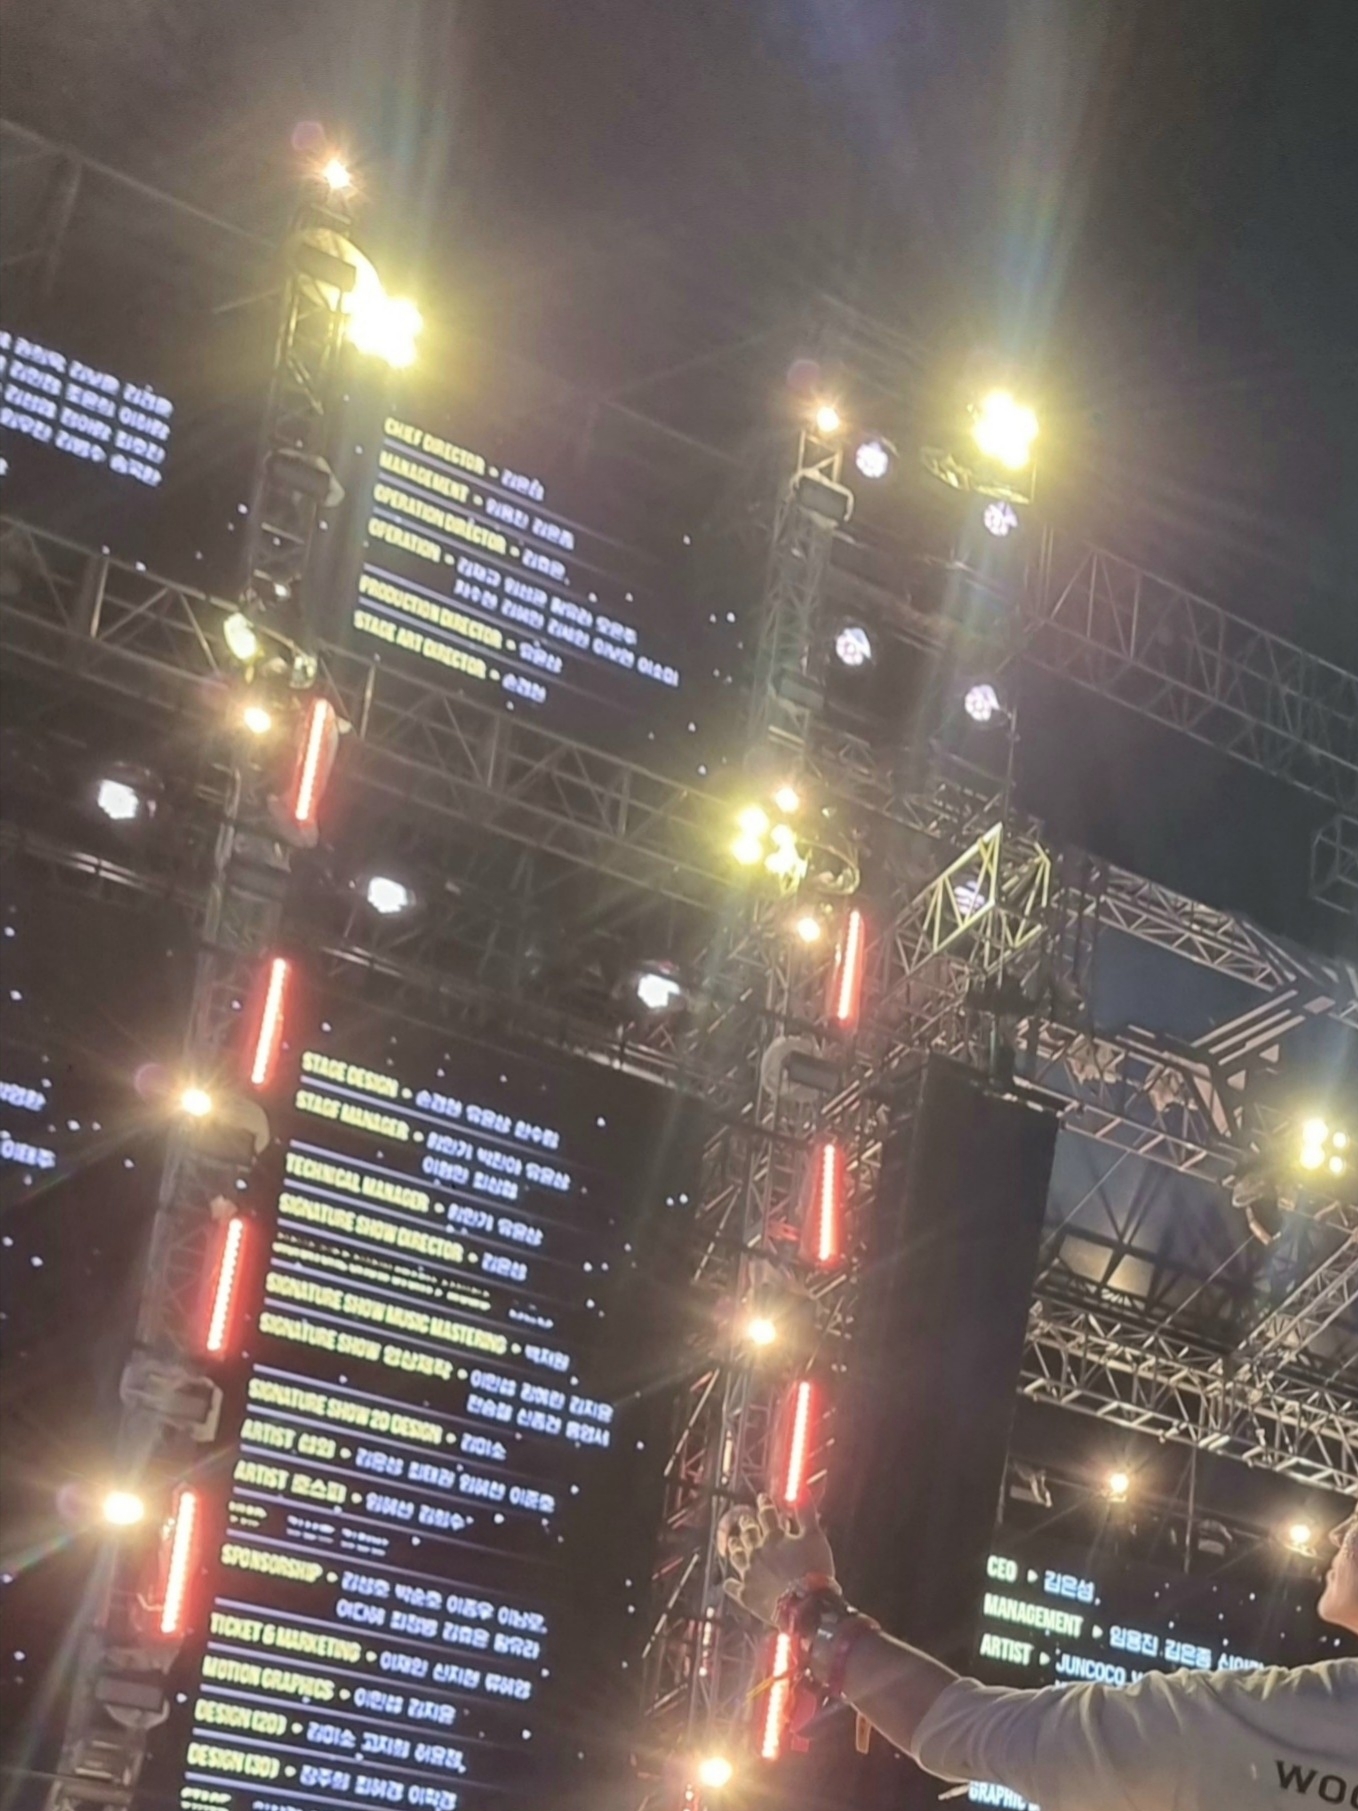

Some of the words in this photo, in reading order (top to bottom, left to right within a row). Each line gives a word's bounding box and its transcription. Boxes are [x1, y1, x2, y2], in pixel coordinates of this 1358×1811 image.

[380, 451, 468, 502] MANAGEMENT
[423, 433, 485, 474] DIRECTOR
[369, 518, 440, 561] OPERATION
[374, 484, 445, 527] OPERATION
[444, 514, 506, 553] DIRECTOR
[359, 575, 440, 622] PRODUCTION
[440, 608, 502, 648] DIRECTOR
[354, 611, 396, 642] STAGE
[396, 628, 423, 651] ART
[423, 639, 486, 678] DIRECTOR
[302, 1052, 347, 1081] STAGE
[347, 1066, 398, 1097] DESIGN
[296, 1090, 341, 1118] STAGE
[340, 1104, 409, 1140] MANAGER
[286, 1153, 361, 1193] TECHNICAL
[362, 1176, 429, 1212] MANAGER
[279, 1193, 356, 1231] SIGNATURE
[355, 1215, 398, 1243] SHOW
[397, 1227, 463, 1262] DIRECTOR
[260, 1313, 337, 1349] SIGNATURE
[337, 1333, 381, 1360] SHOW
[266, 1272, 344, 1310] SIGNATURE
[343, 1294, 387, 1321] SHOW
[385, 1305, 430, 1333] MUSIC
[429, 1317, 507, 1354] MASTERING
[241, 1419, 296, 1448] ARTIST
[249, 1379, 327, 1415] SIGNATURE
[326, 1399, 371, 1425] SHOW
[390, 1414, 442, 1443] DESIGN
[234, 1460, 289, 1489] ARTIST
[221, 1543, 323, 1582] SPONSORSHIP
[987, 1555, 1018, 1582] CEO
[211, 1612, 263, 1641] TICKET
[276, 1627, 361, 1662] MARKETING
[983, 1593, 1084, 1639] MANAGEMENT
[203, 1656, 261, 1685] MOTION
[261, 1668, 334, 1700] GRAPHICS
[980, 1633, 1034, 1666] ARTIST
[1055, 1653, 1126, 1684] JUNCOCO
[195, 1699, 252, 1728] DESIGN
[187, 1743, 245, 1772] DESIGN
